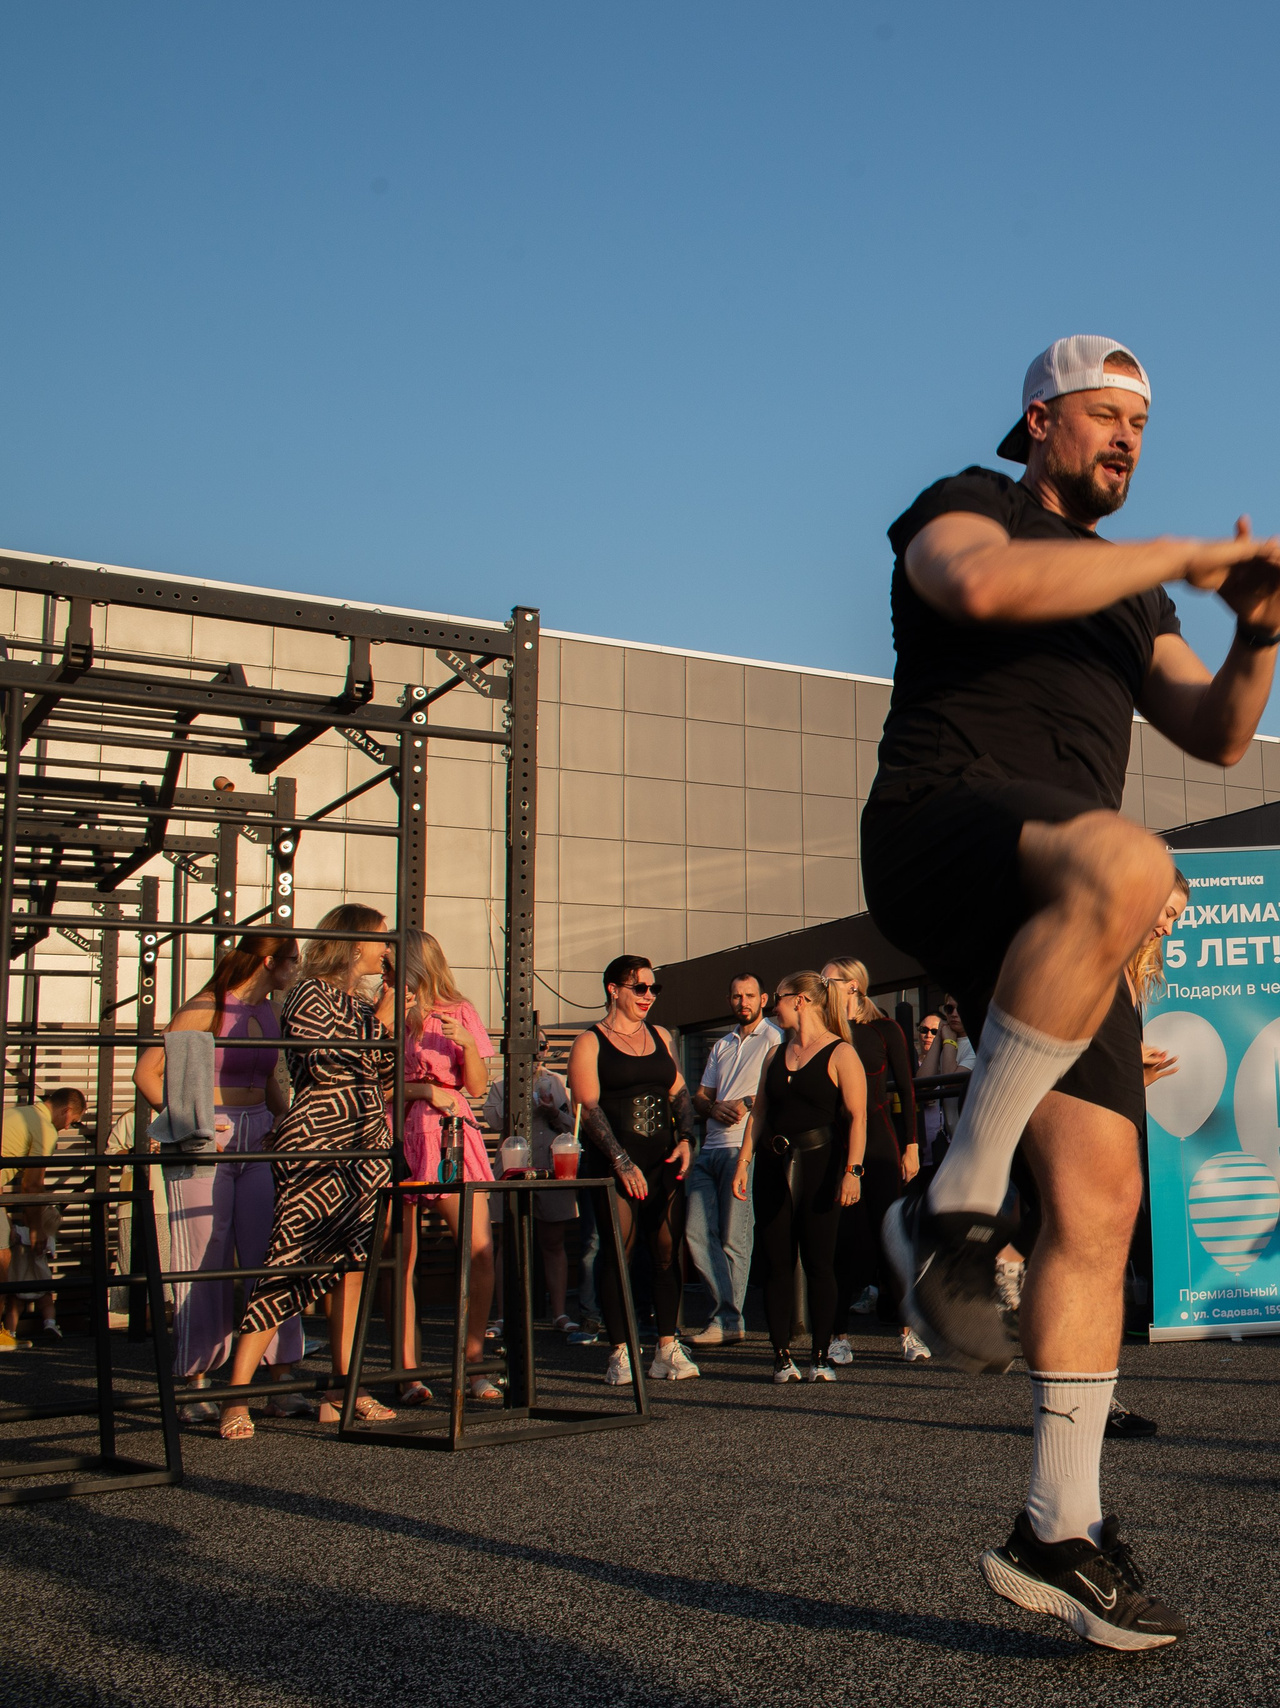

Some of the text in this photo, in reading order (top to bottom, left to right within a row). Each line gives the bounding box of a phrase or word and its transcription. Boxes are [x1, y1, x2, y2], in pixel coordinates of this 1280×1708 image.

[1186, 875, 1264, 888] жиматика
[1165, 940, 1187, 968] 5
[1167, 982, 1241, 1000] Подарки
[1247, 983, 1256, 994] в
[1179, 1283, 1278, 1303] Премиальный
[1193, 1310, 1209, 1320] ул.
[1212, 1308, 1262, 1318] Садовая,
